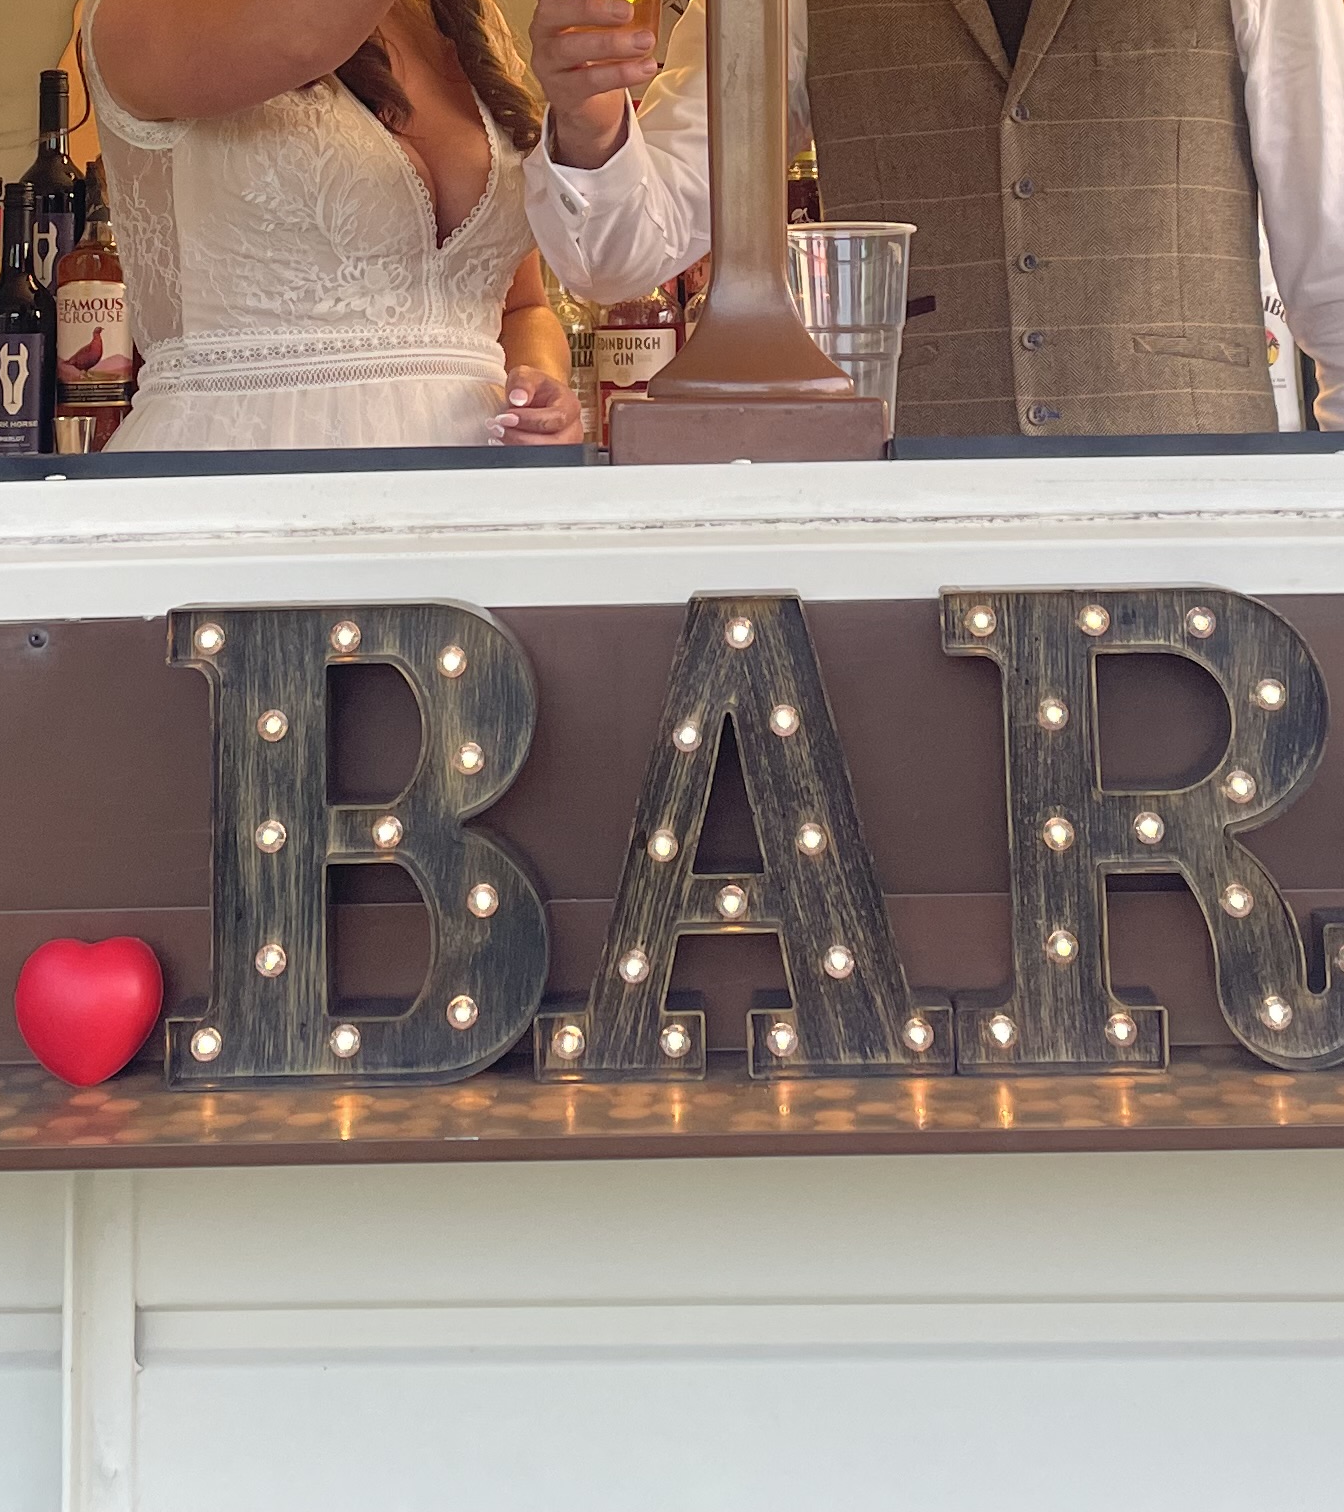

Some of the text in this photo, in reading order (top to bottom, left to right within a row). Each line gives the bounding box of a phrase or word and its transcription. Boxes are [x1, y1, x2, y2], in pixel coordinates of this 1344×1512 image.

[64, 298, 124, 312] FAMOUS
[63, 311, 124, 324] GROUSE
[598, 336, 661, 351] EDINBURGH
[613, 352, 634, 366] GIN
[10, 420, 39, 428] HORSE
